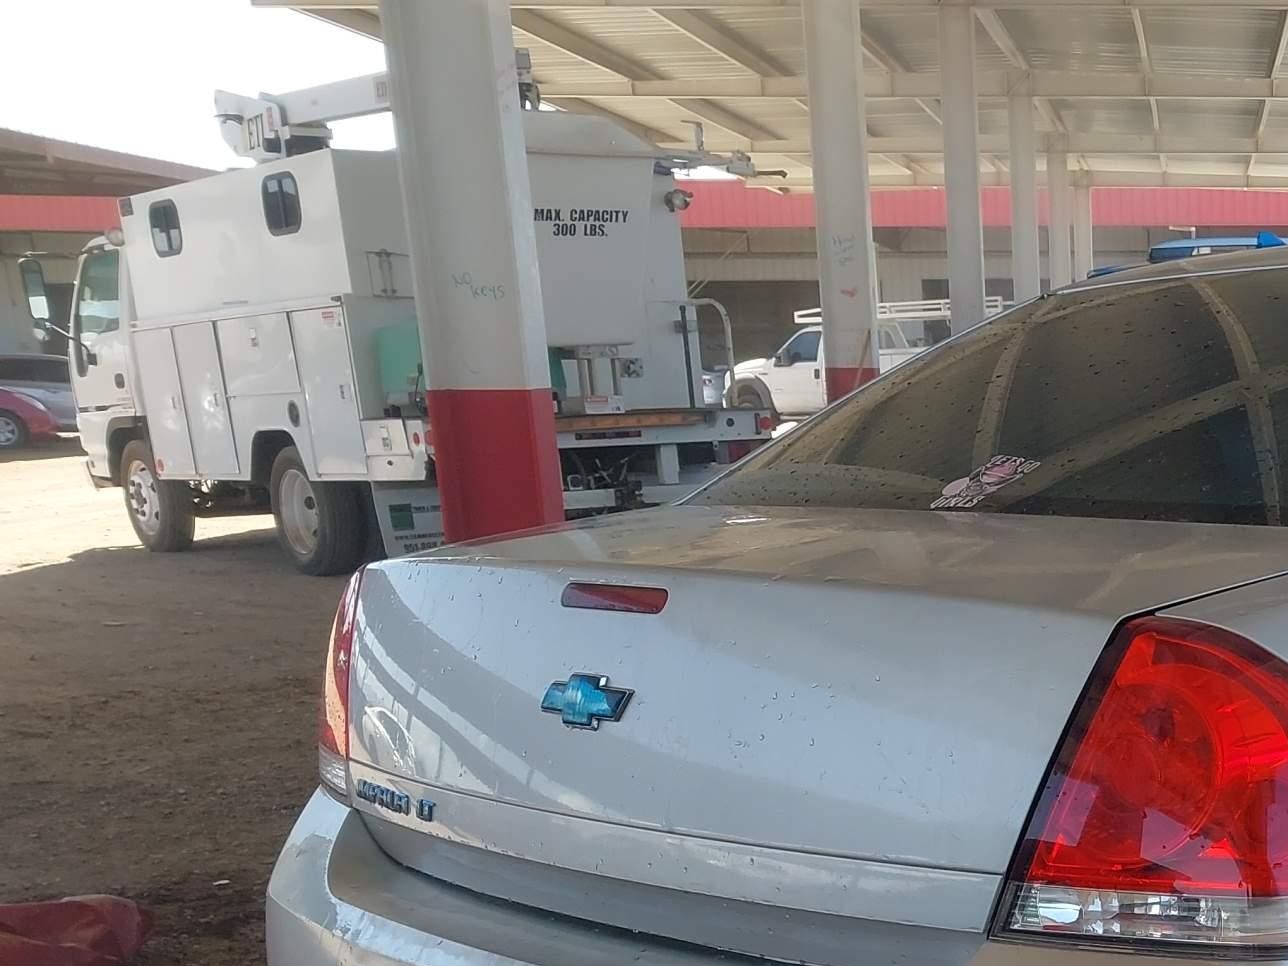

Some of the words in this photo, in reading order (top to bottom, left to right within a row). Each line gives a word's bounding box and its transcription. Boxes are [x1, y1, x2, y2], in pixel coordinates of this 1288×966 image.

[533, 208, 565, 222] MAX.
[569, 208, 629, 223] CAPACITY
[553, 223, 577, 237] 300
[584, 224, 608, 238] LBS.
[930, 495, 986, 509] GIRLS
[416, 799, 437, 822] LT
